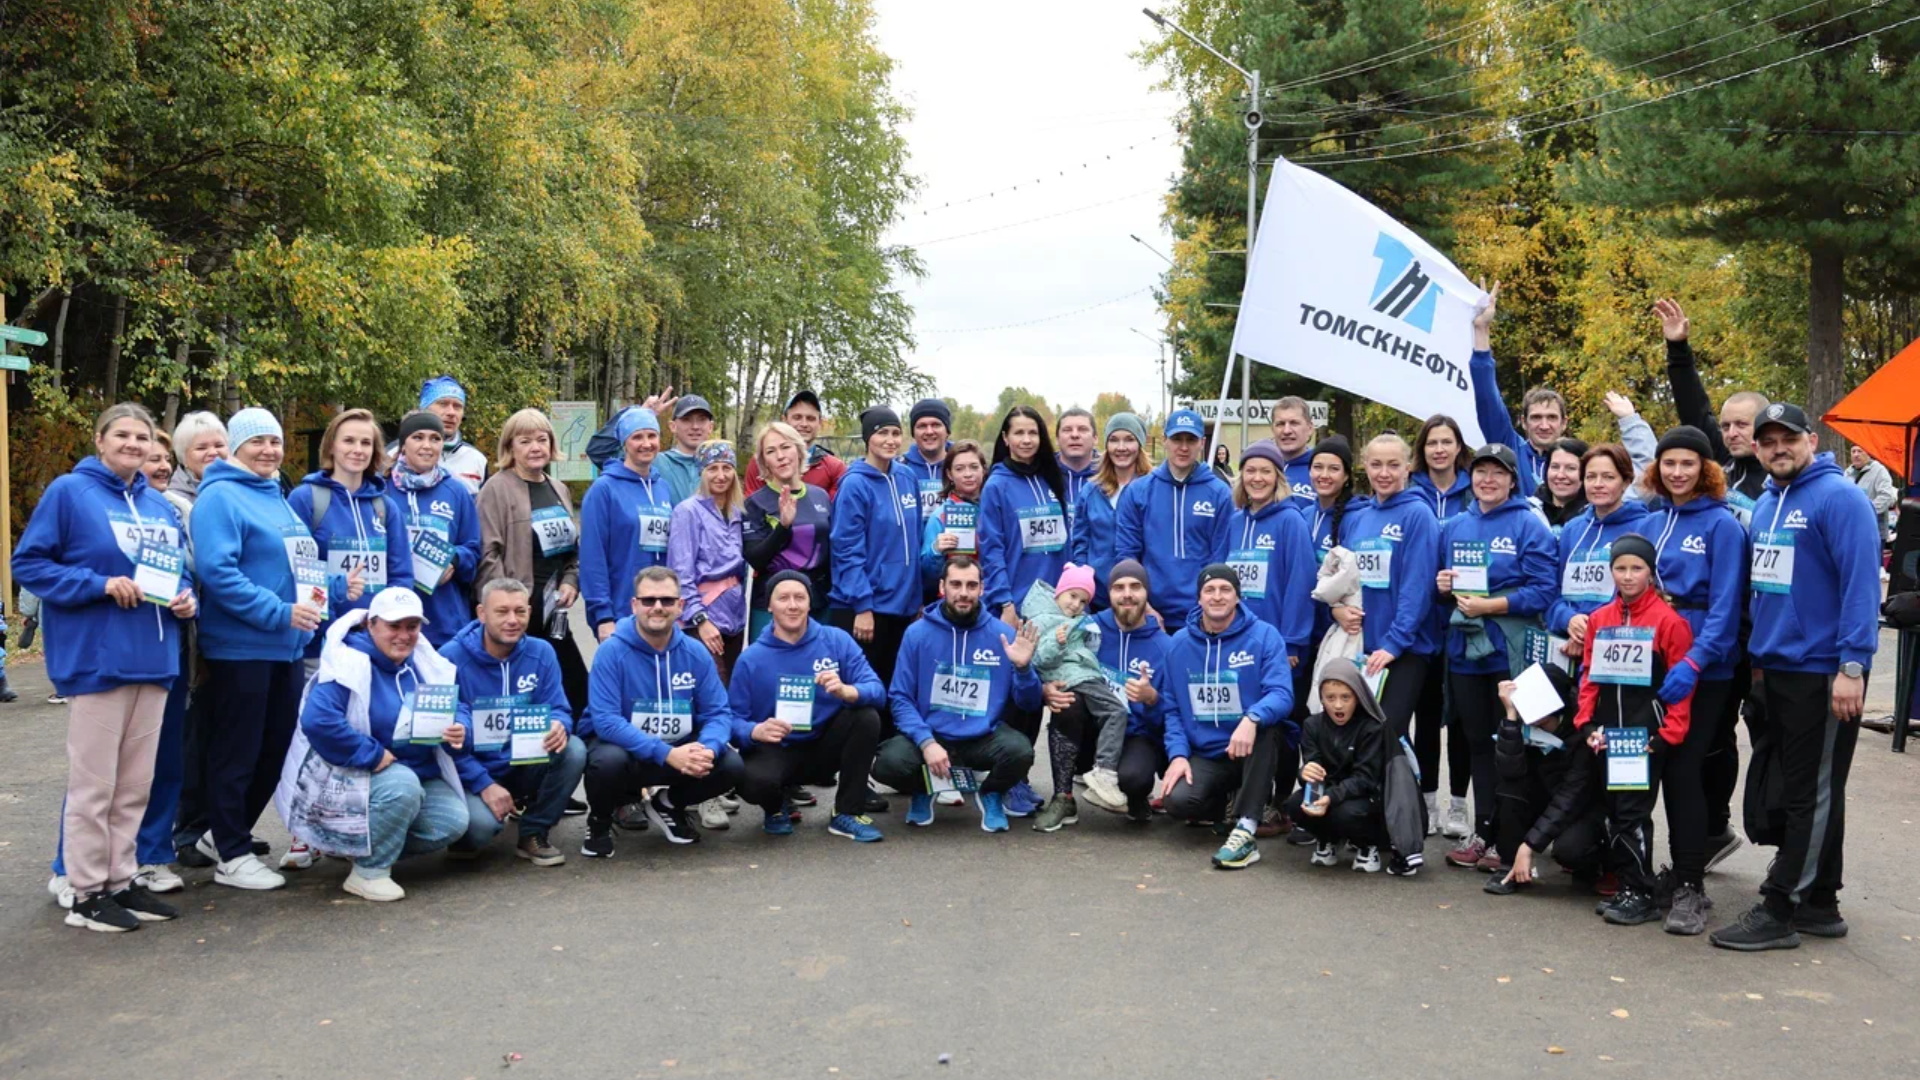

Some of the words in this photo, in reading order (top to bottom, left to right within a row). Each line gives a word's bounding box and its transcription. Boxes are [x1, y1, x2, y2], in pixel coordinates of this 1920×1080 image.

[1299, 303, 1469, 391] ТОМСКНЕФТЬ
[544, 521, 570, 538] 5514
[1029, 519, 1058, 537] 5437
[1453, 549, 1484, 558] КРОСС
[1752, 548, 1780, 569] 707
[340, 554, 380, 572] 4749
[1356, 554, 1380, 571] 851
[1603, 643, 1644, 663] 4672
[779, 684, 811, 694] КРОСС
[941, 678, 979, 699] 4472
[417, 694, 453, 704] КРОСС
[513, 715, 547, 726] КРОСС
[641, 716, 681, 735] 4358
[1609, 739, 1643, 749] КРОСС
